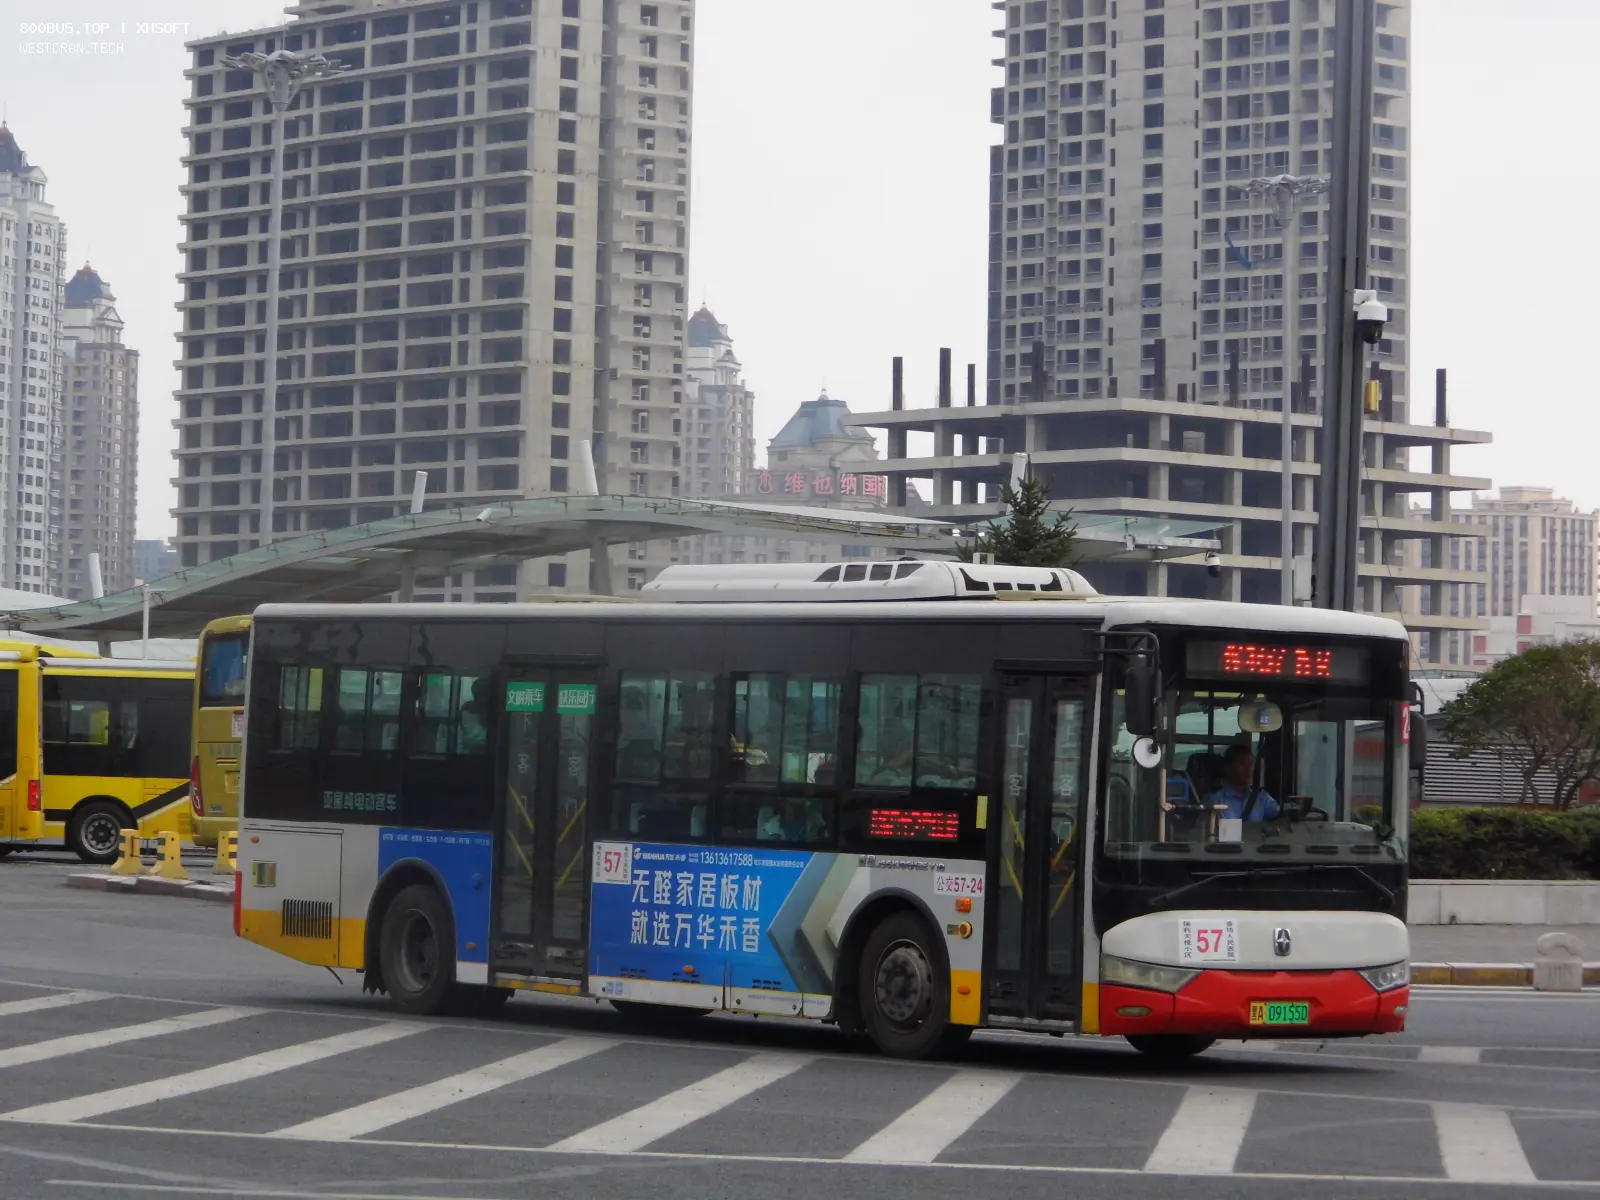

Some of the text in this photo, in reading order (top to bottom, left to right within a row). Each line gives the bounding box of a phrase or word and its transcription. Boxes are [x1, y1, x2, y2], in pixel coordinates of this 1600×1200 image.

[604, 851, 621, 873] 57
[700, 852, 753, 867] 13613617588
[631, 869, 762, 911] 无醛家居板材
[936, 876, 983, 893] 公交57-24
[630, 909, 760, 953] 就选万华禾香
[1197, 929, 1223, 953] 57
